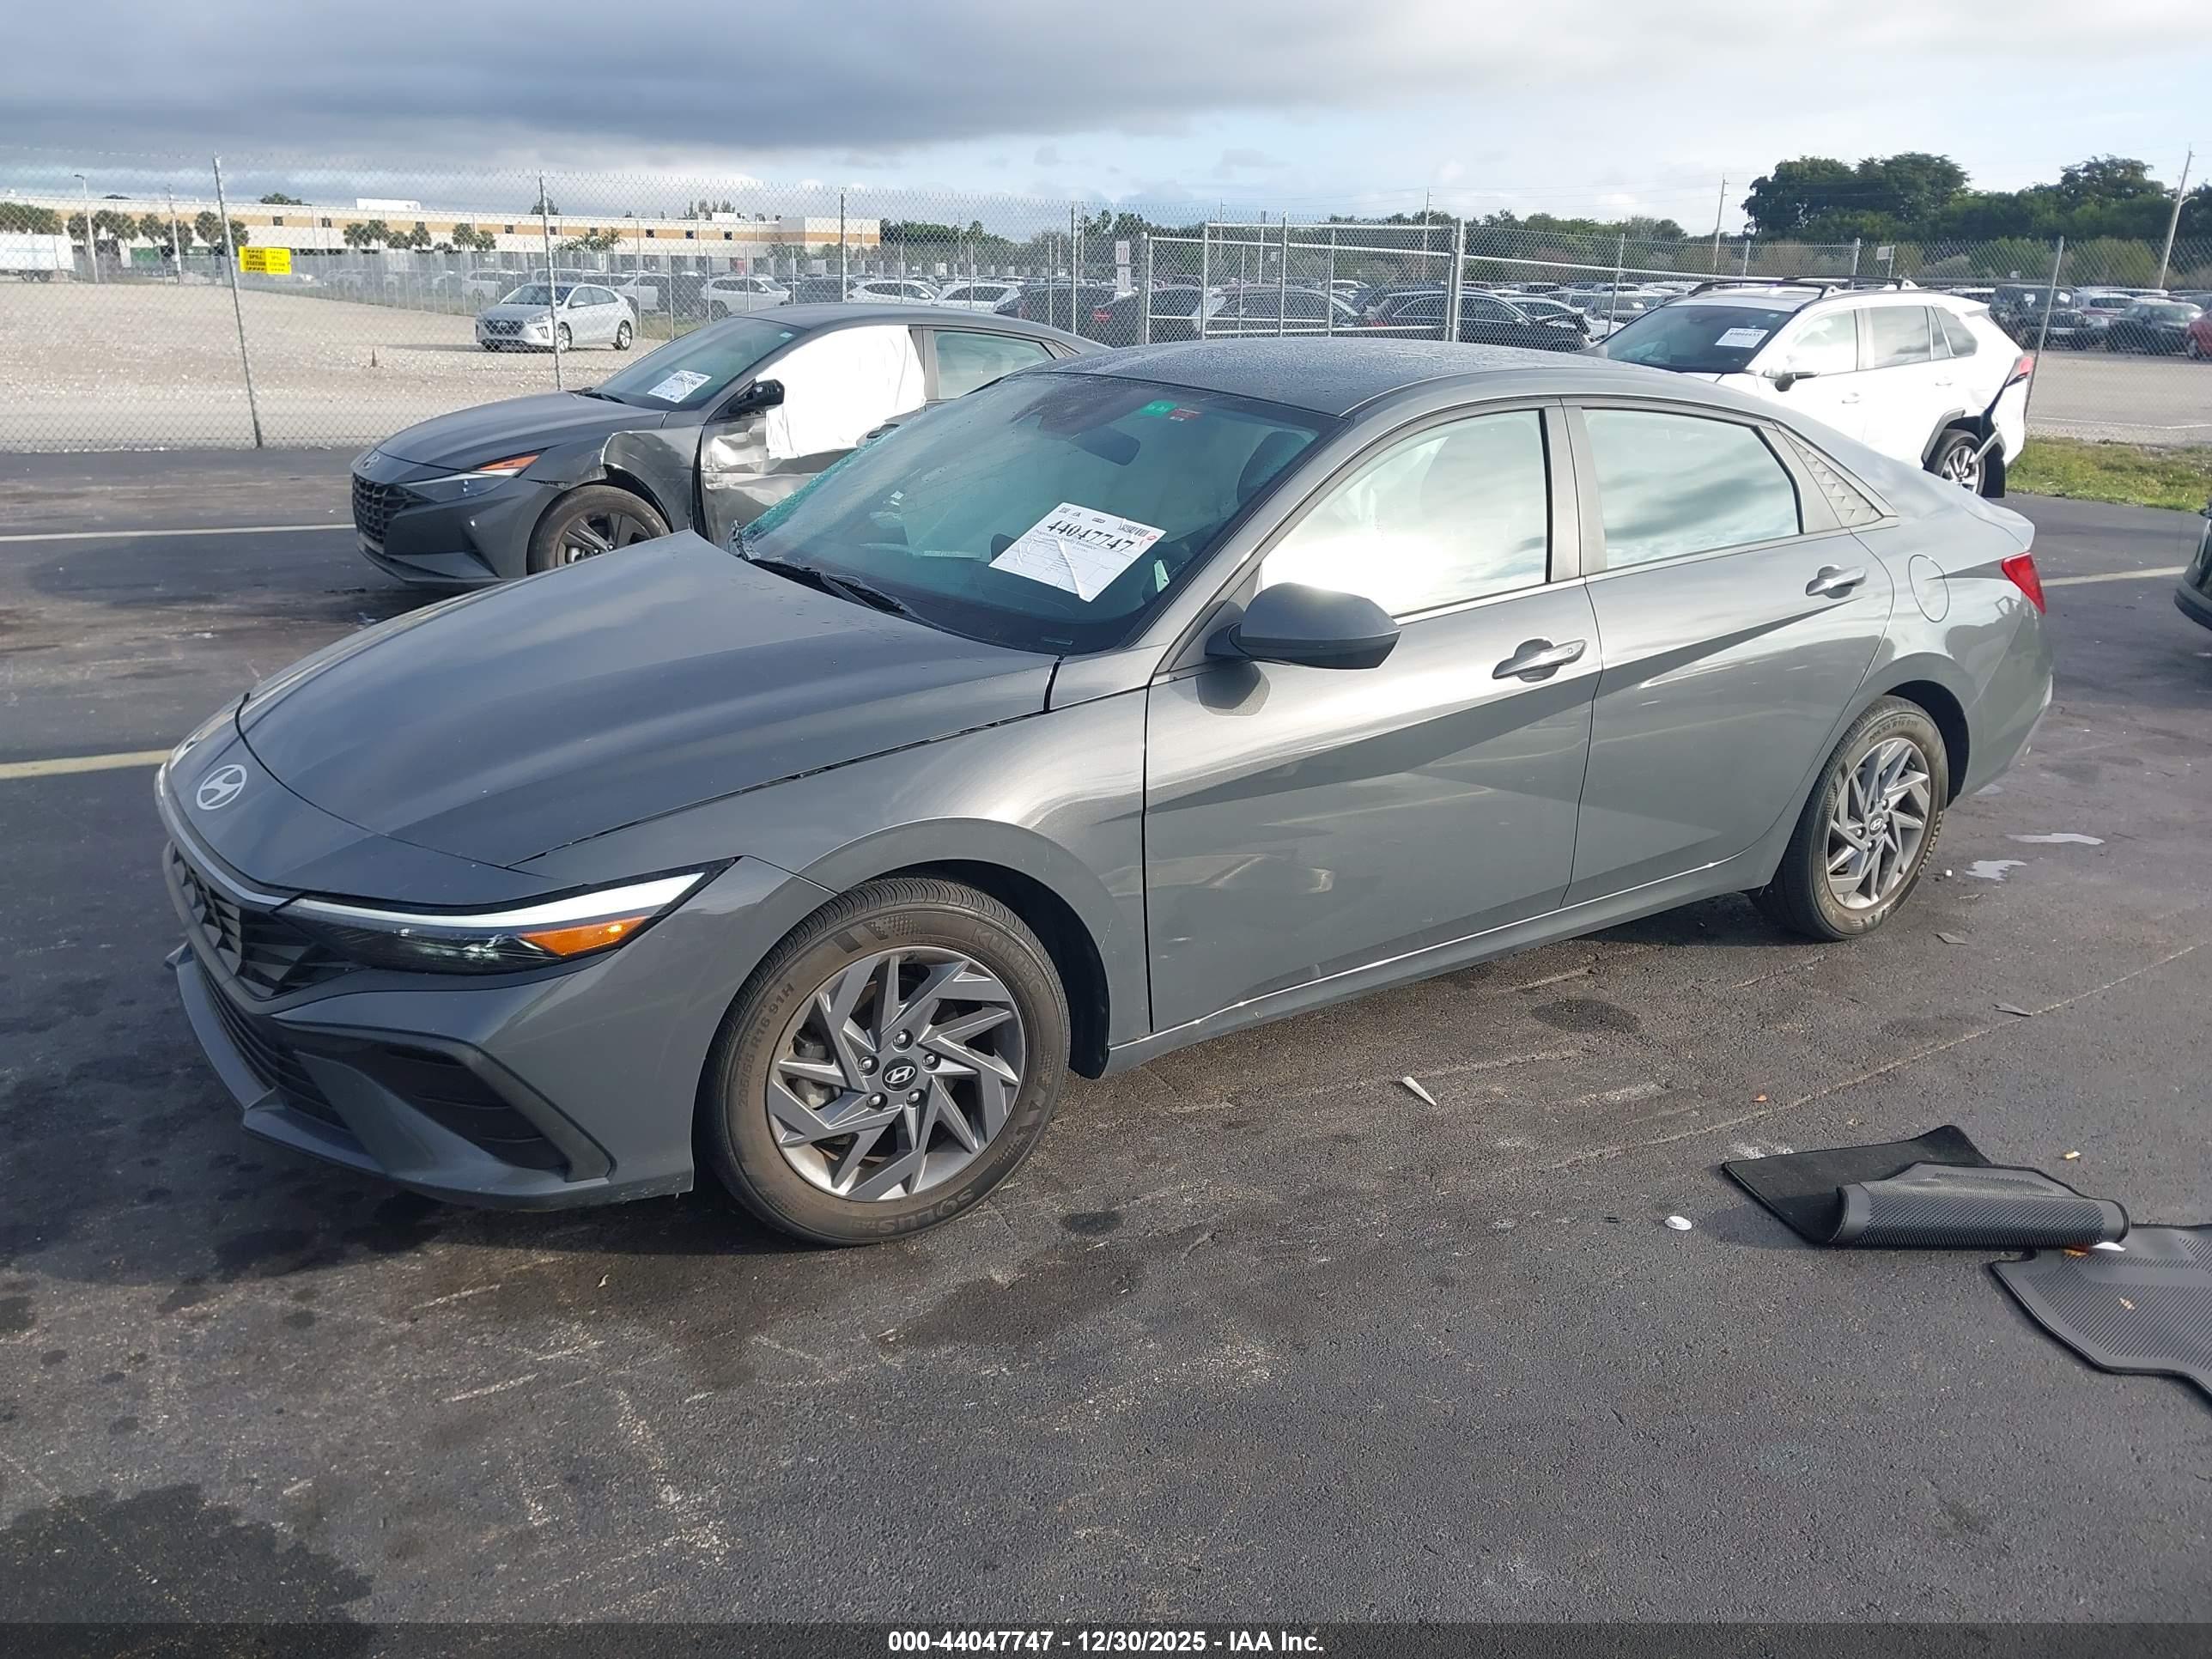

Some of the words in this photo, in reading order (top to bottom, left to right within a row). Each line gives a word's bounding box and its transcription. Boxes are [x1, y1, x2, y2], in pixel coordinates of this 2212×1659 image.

[1117, 247, 1128, 263] 70
[1047, 520, 1135, 552] 44047747
[970, 927, 1043, 997] KUMHO
[769, 982, 795, 1016] 91H
[878, 1188, 975, 1233] SOLUS
